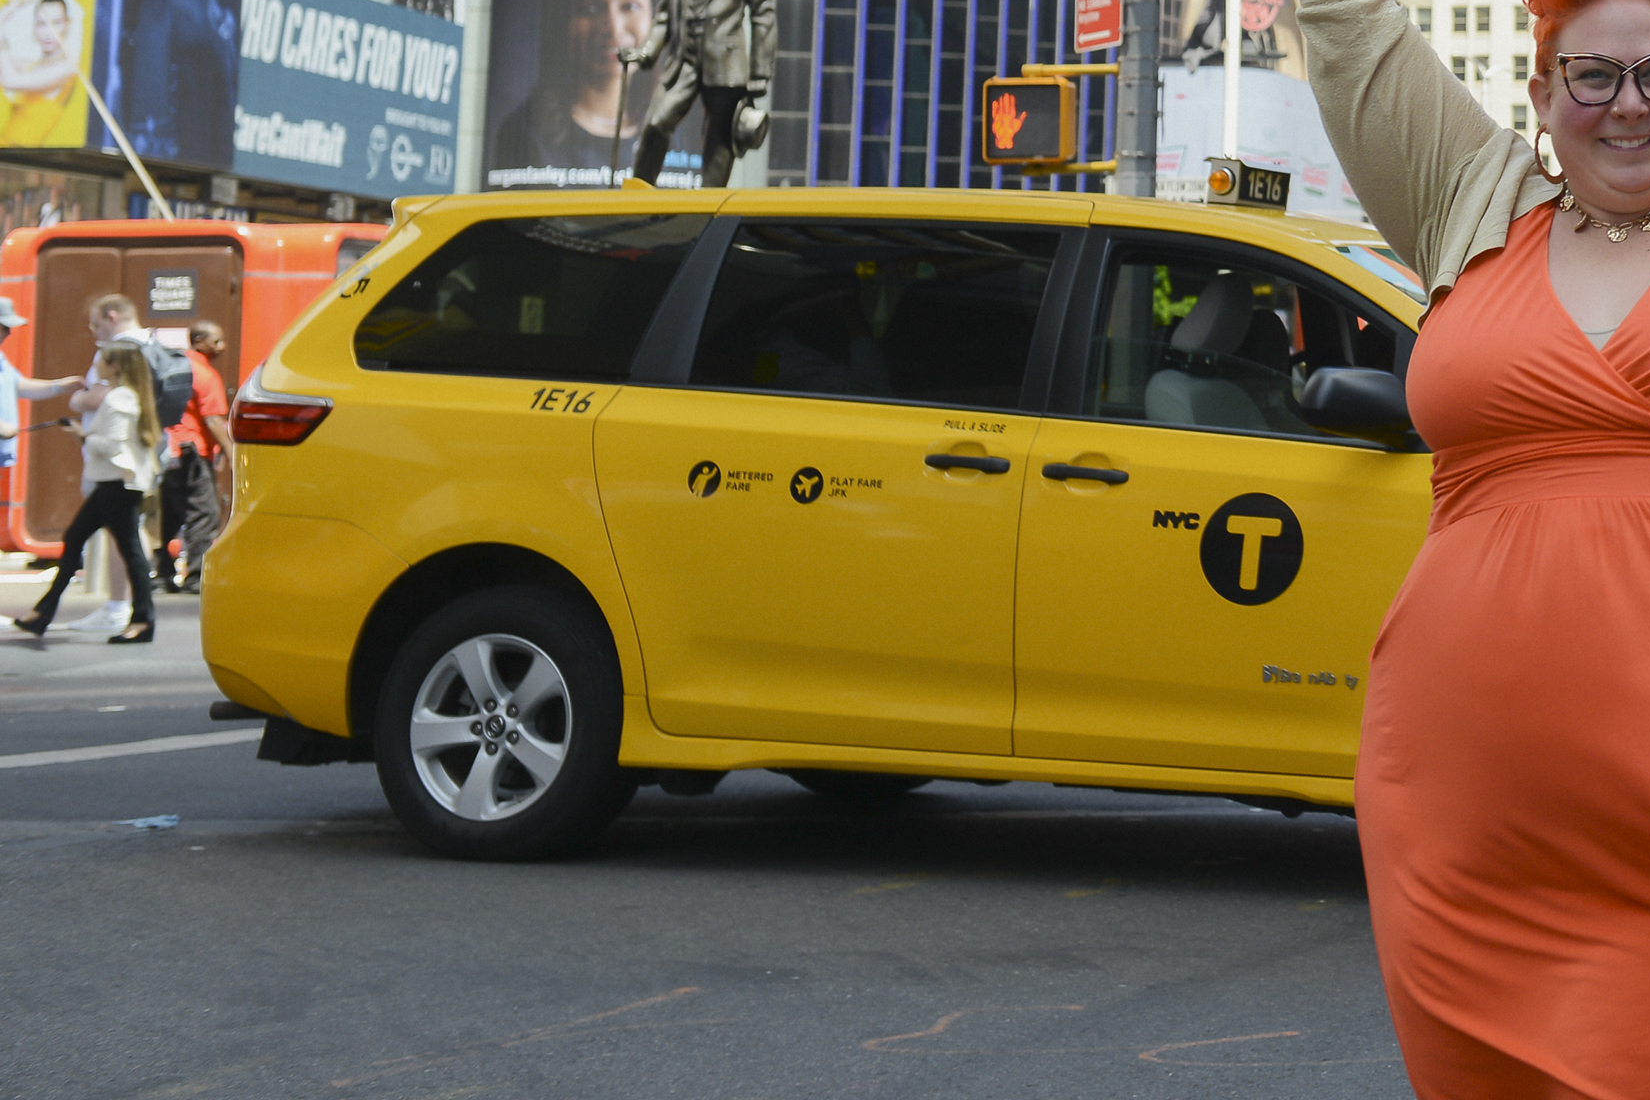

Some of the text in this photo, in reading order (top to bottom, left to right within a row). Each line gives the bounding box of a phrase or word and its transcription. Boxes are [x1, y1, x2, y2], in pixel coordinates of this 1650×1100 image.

[280, 2, 360, 82] CARES
[355, 23, 403, 92] FOR
[402, 34, 459, 104] YOU?
[1248, 170, 1281, 201] 1E16
[154, 276, 192, 288] TIMES
[150, 288, 194, 300] SQUARE
[530, 387, 595, 413] 1E16
[943, 419, 966, 430] PULL
[978, 422, 1007, 433] SLIDE
[727, 470, 773, 482] METERED
[726, 482, 751, 492] FARE
[830, 477, 882, 489] FLAT FARE
[828, 488, 847, 498] JFK
[1153, 510, 1283, 590] NYC T
